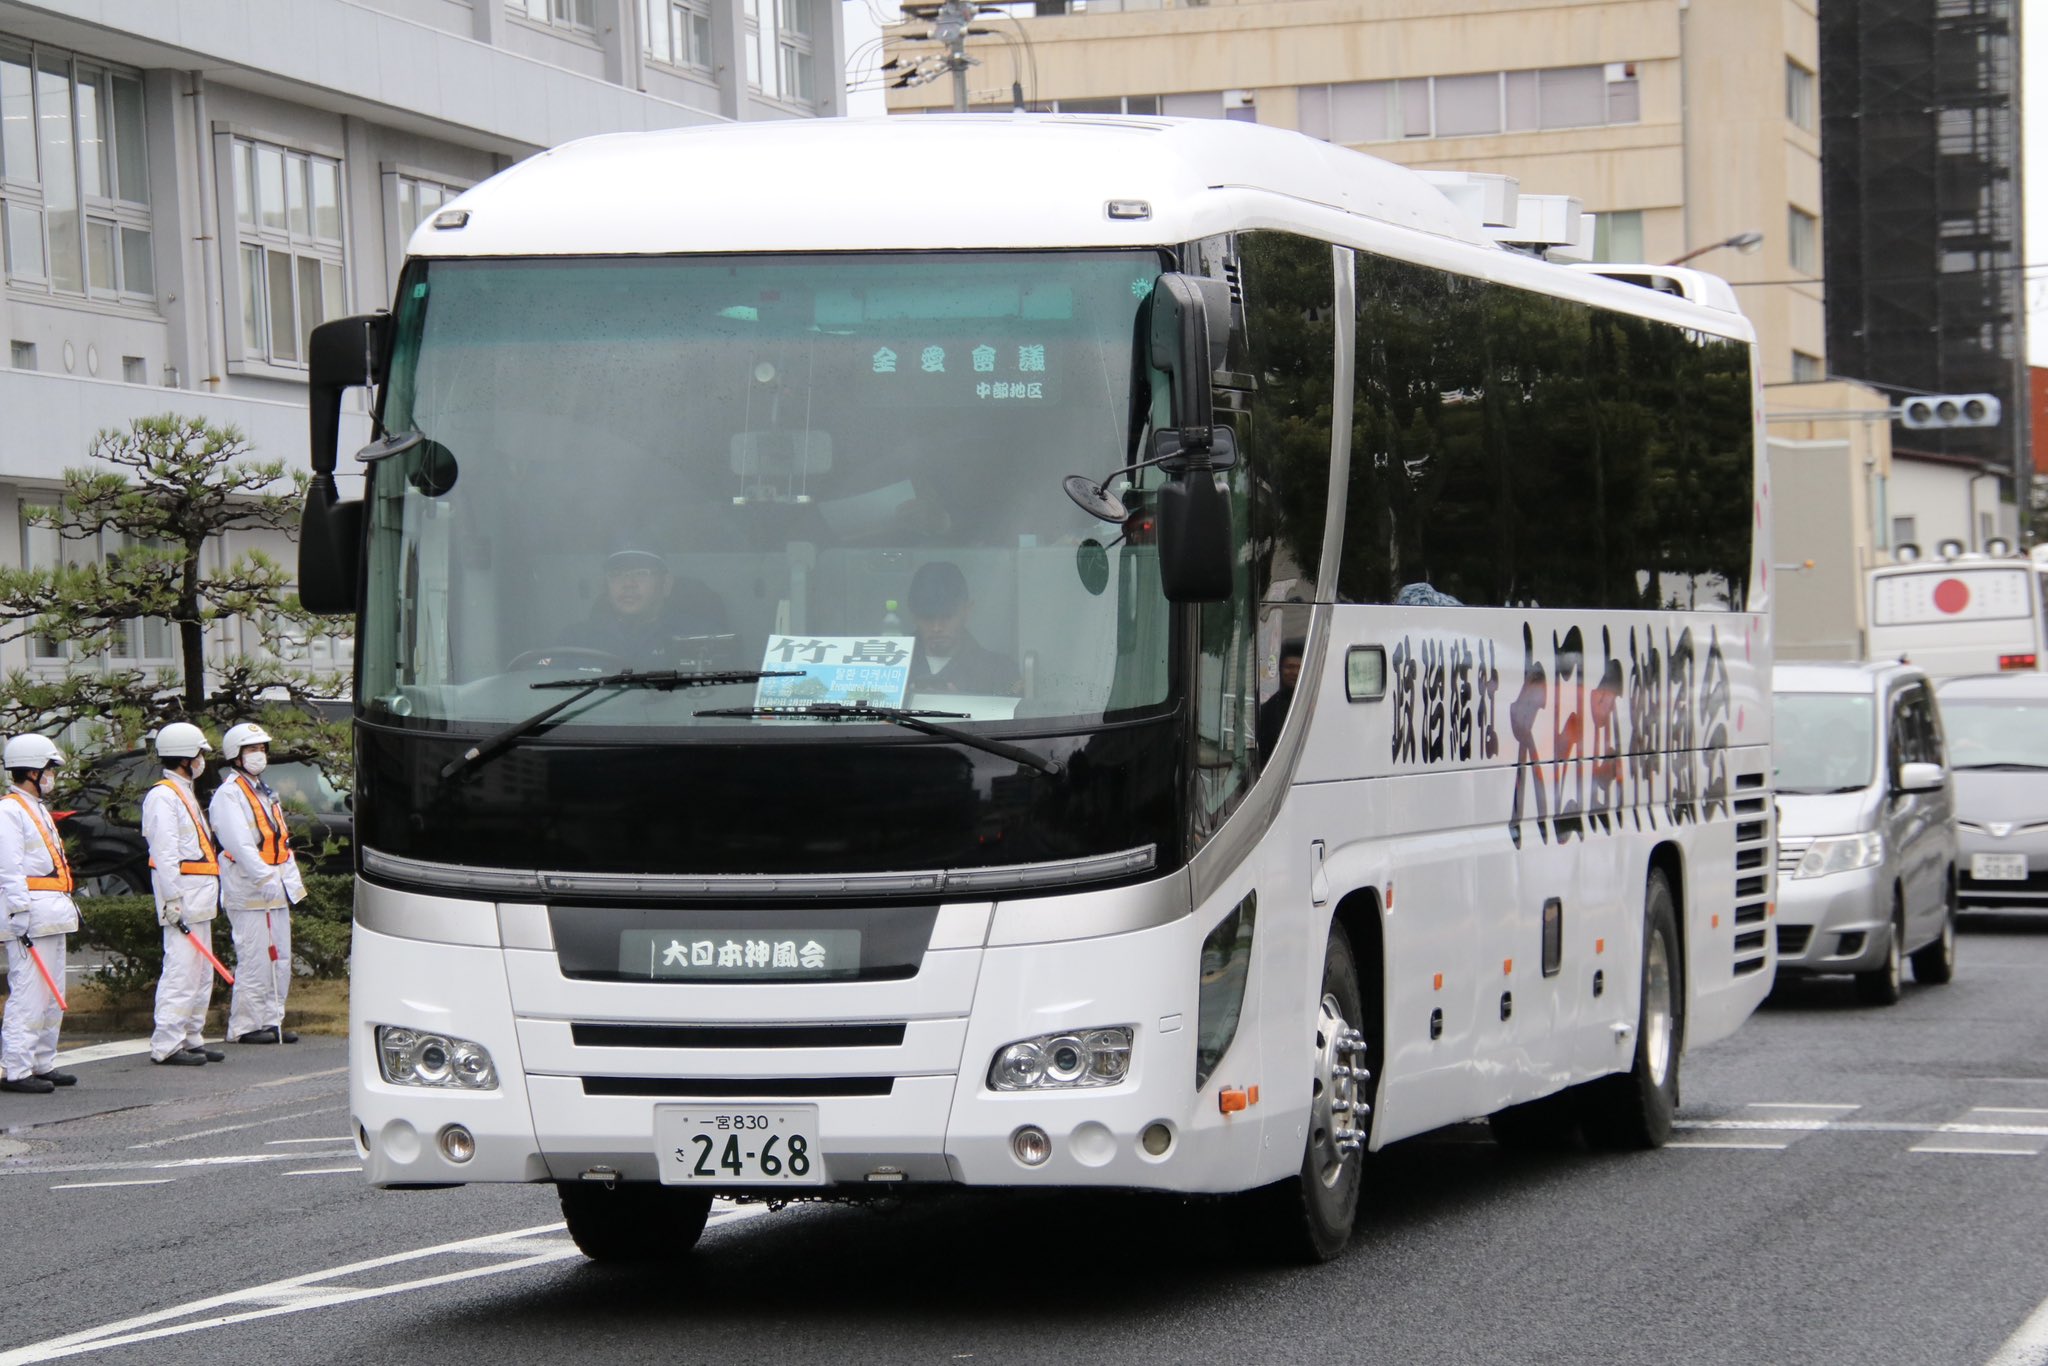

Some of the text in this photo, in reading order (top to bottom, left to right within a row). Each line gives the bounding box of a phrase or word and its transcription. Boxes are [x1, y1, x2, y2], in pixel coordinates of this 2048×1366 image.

[976, 382, 1043, 400] 中部地区
[769, 638, 910, 666] 竹島
[1392, 634, 1500, 765] 政治結社
[1508, 621, 1732, 851] 大日本神風会
[662, 940, 827, 969] 大日本神風会
[675, 1134, 810, 1177] さ 24-68
